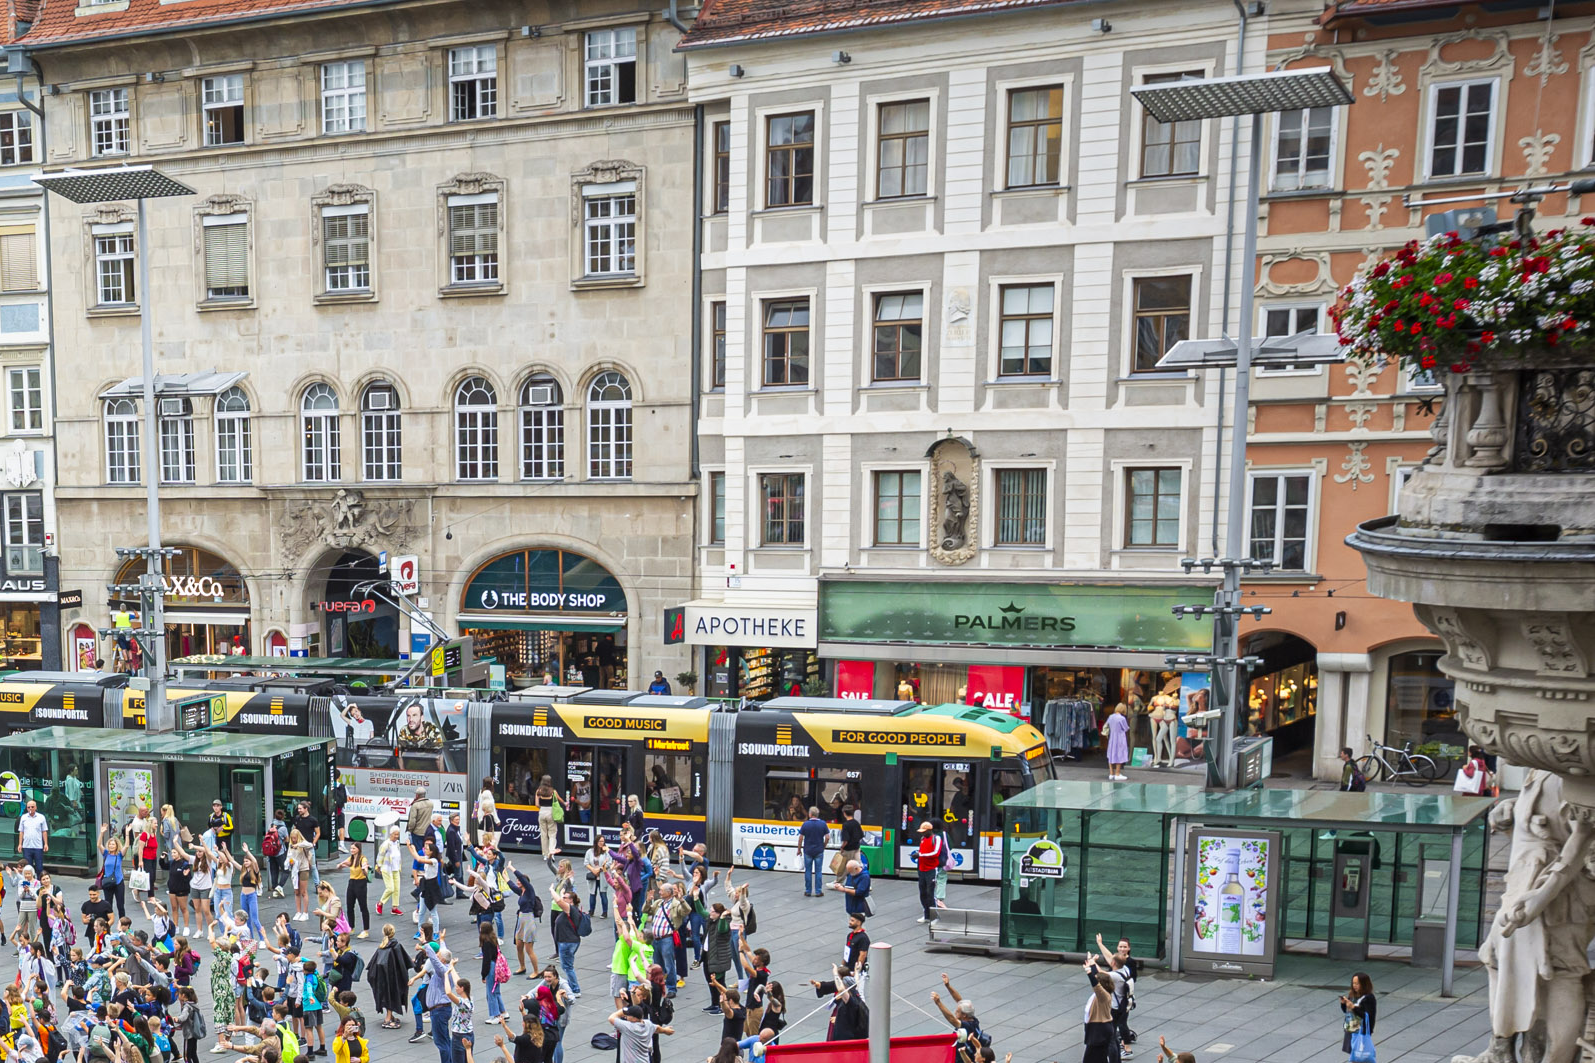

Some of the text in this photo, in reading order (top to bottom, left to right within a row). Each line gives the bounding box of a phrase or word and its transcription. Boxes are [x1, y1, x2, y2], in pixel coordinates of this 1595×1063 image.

[161, 577, 224, 597] AX&Co.
[501, 592, 605, 608] THE BODY SHOP
[318, 601, 360, 612] ruefa
[695, 616, 806, 637] APOTHEKE
[954, 614, 1076, 632] PALMERS
[840, 691, 869, 700] SALE
[132, 699, 146, 708] FO
[37, 708, 88, 720] SOUNDPORTAL
[242, 714, 298, 726] SOUNDPORTAL
[588, 718, 662, 730] GOOD MUSIC
[502, 724, 564, 738] SOUNDPORTAL
[839, 731, 960, 745] FOR GOOD PEOPLE
[648, 739, 652, 749] 1
[742, 743, 810, 757] SOUNDPORTAL
[369, 777, 430, 787] SEIERSBERG
[347, 796, 373, 805] Müller
[378, 798, 415, 807] Media
[346, 805, 382, 814] RIMARK
[1015, 823, 1020, 833] 1
[572, 831, 587, 839] Mode
